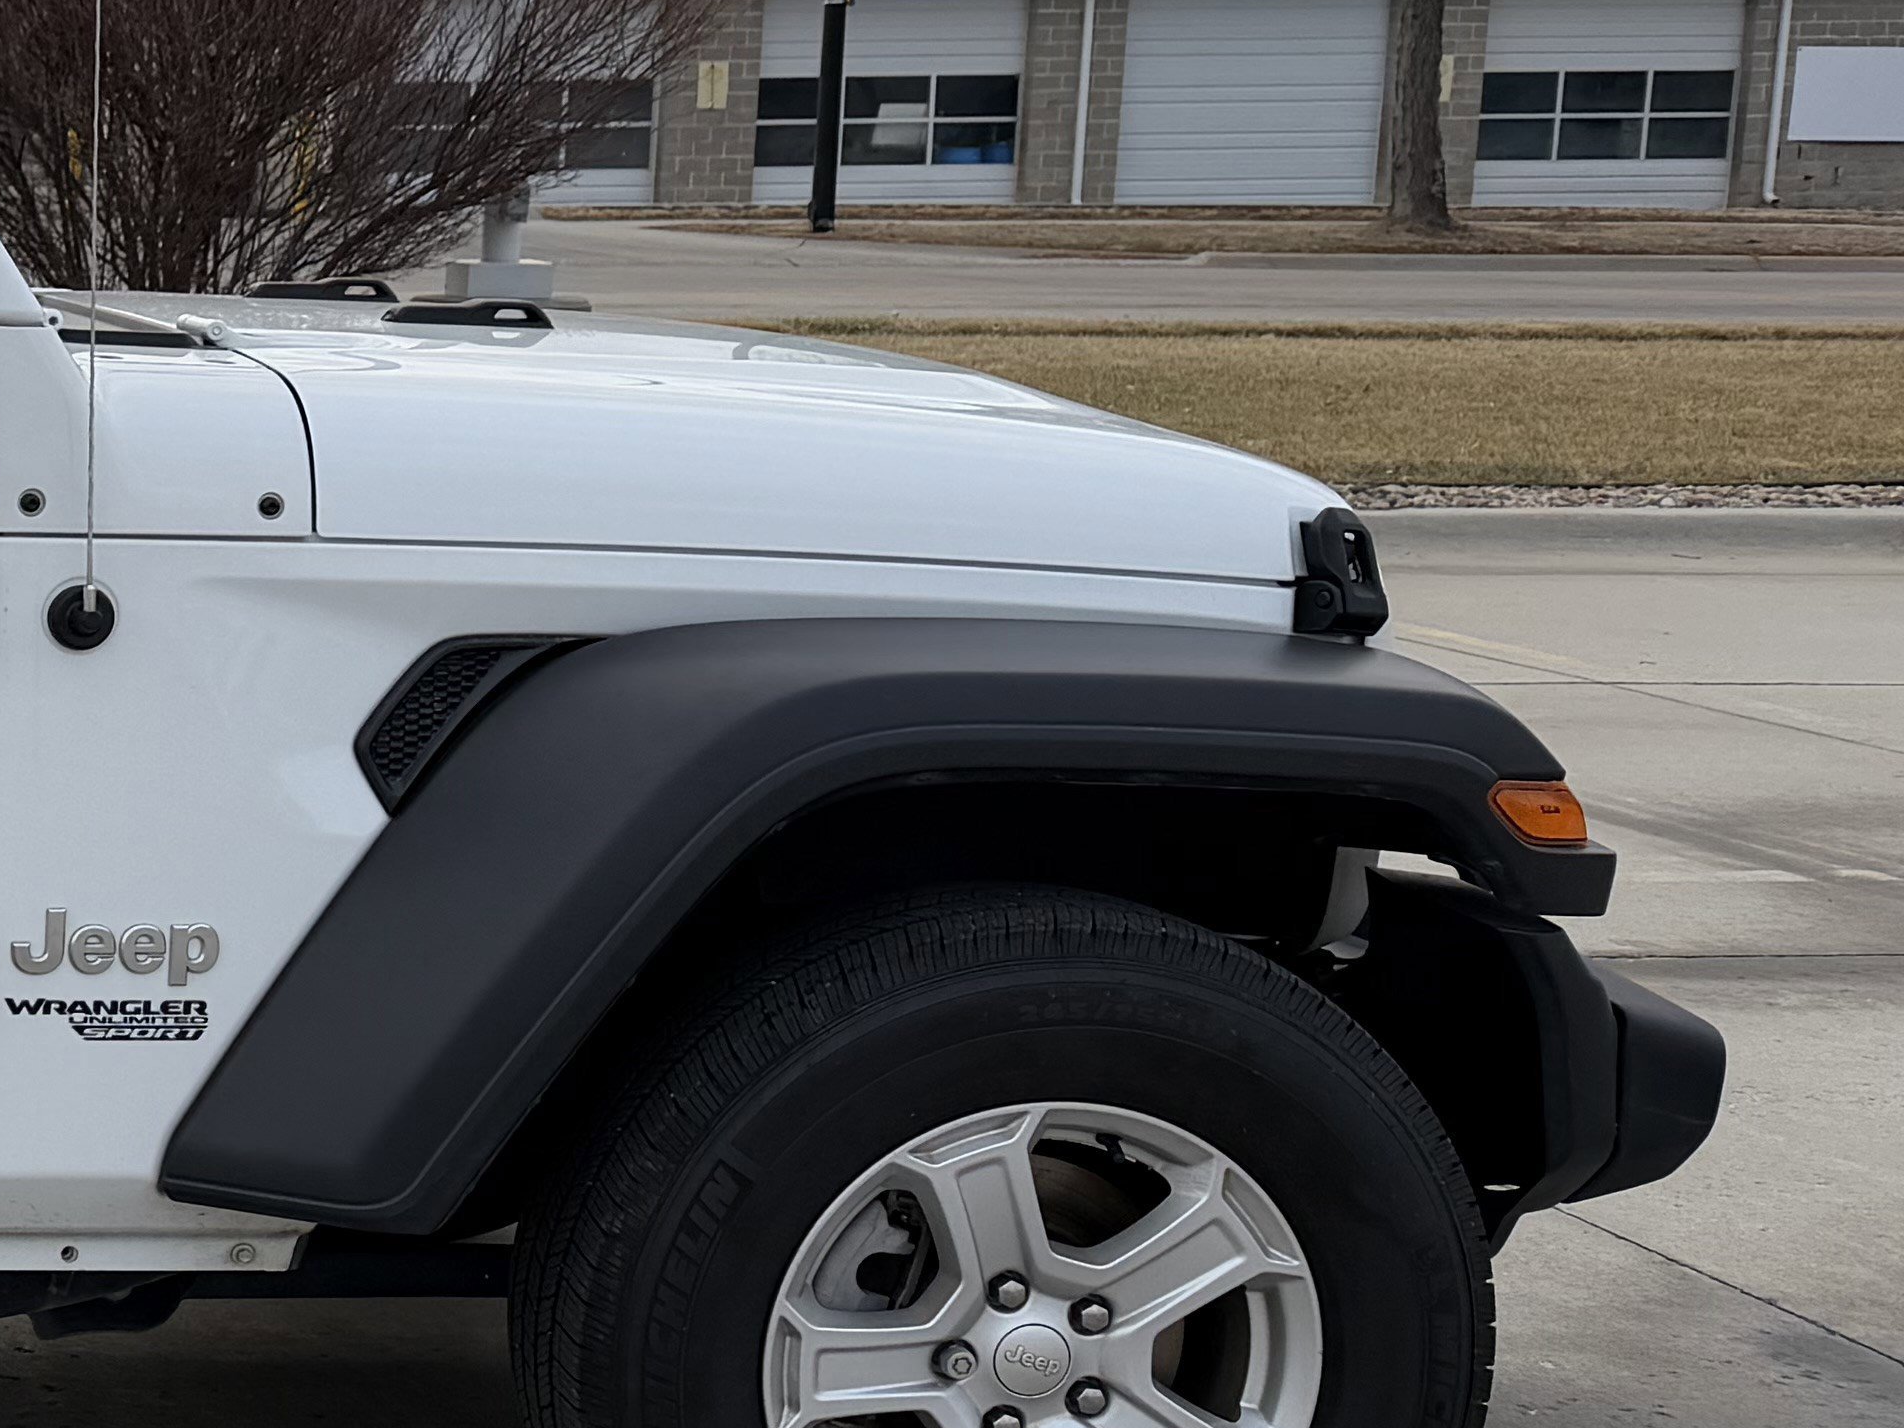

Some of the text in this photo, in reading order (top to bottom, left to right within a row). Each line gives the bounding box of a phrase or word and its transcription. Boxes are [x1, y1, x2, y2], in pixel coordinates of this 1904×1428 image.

[10, 907, 220, 987] Jeep
[4, 997, 209, 1016] WRANGLER
[68, 1016, 209, 1024] UNLIMITED
[81, 1027, 203, 1040] SPORT
[1004, 1344, 1061, 1378] Jeep
